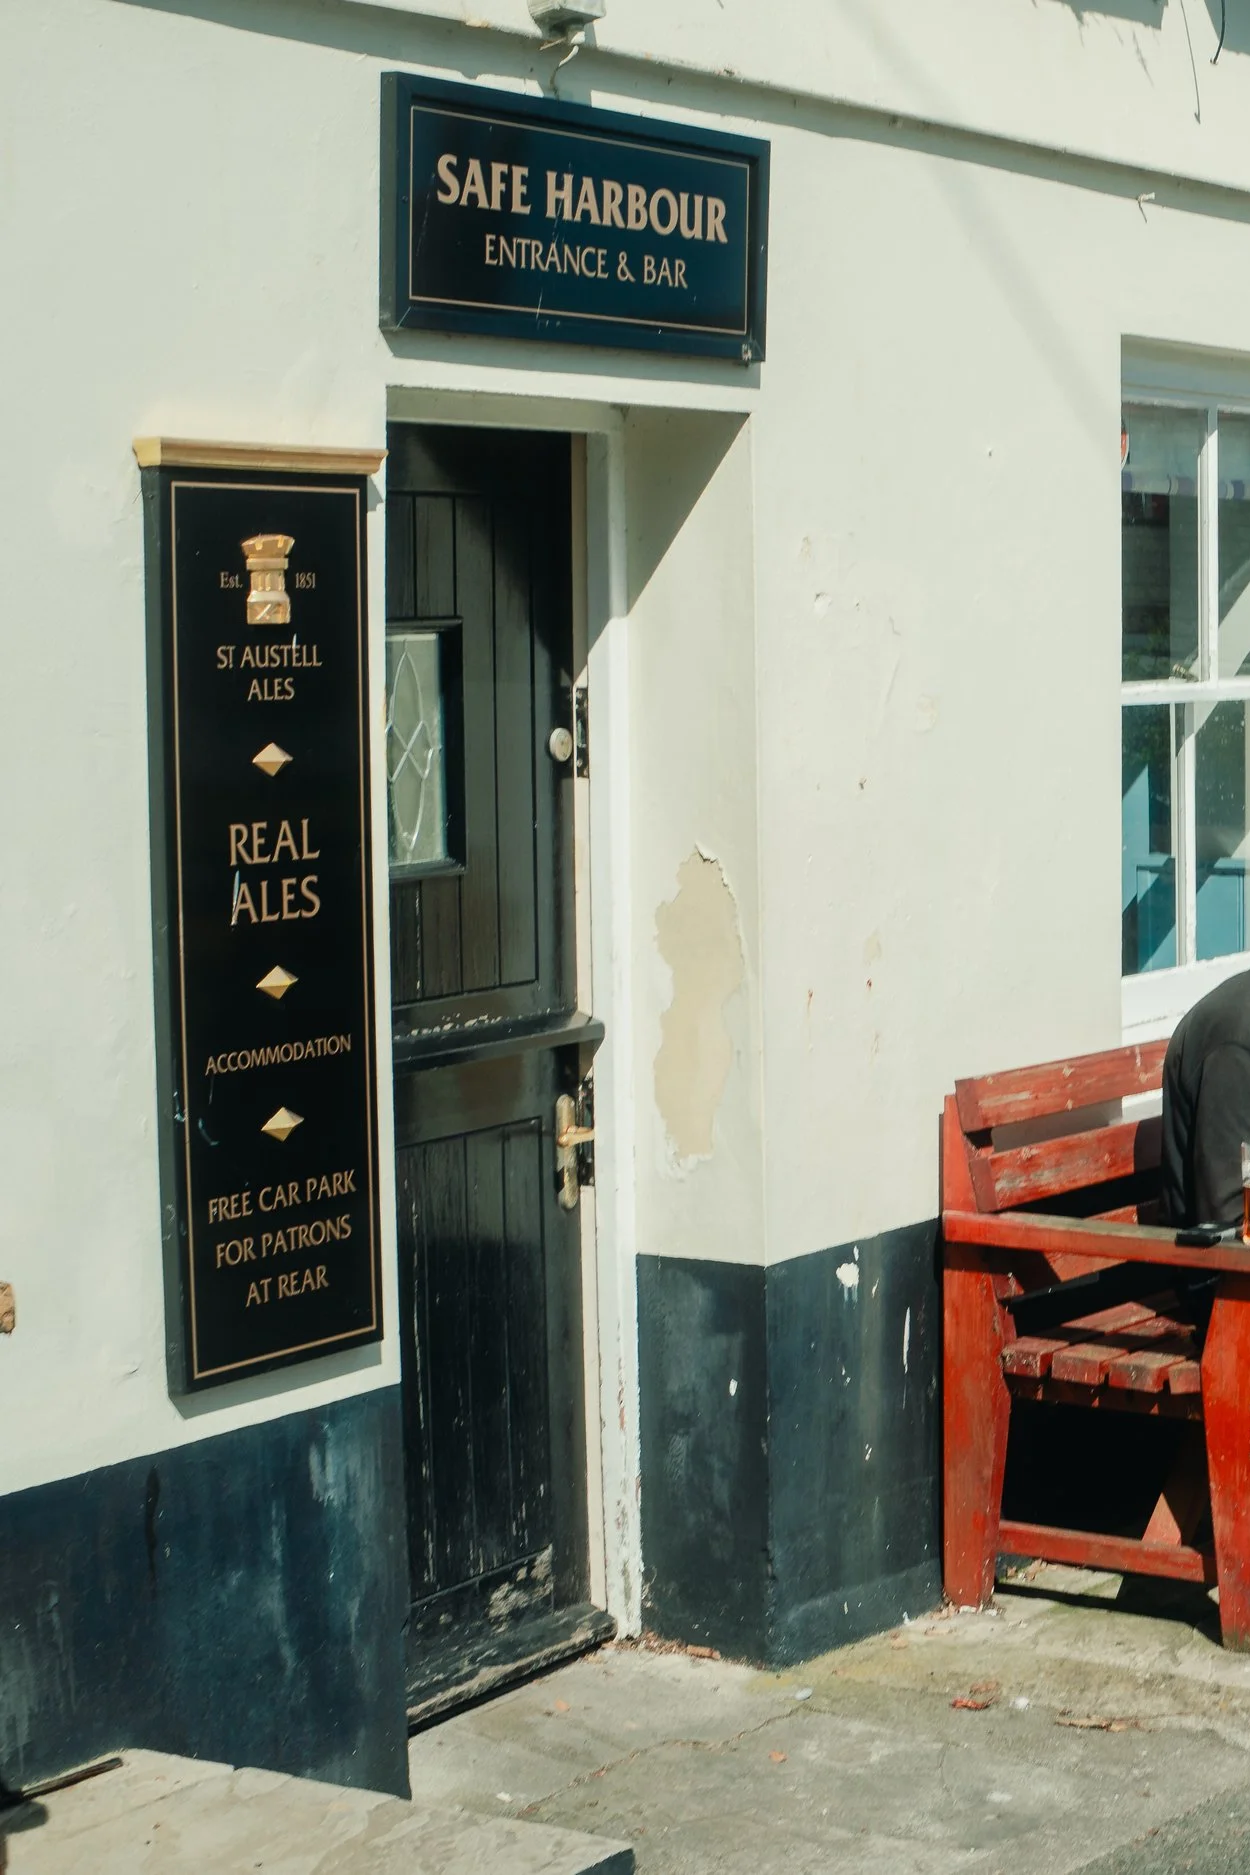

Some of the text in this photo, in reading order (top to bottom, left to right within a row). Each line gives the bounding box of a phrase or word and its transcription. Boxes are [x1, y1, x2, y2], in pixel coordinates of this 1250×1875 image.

[436, 153, 729, 244] SAFE HARBOUR
[485, 234, 688, 288] ENTRANCE & BAR
[220, 571, 316, 590] Est. 1851
[217, 645, 322, 669] ST AUSTELL
[247, 677, 296, 701] ALES
[229, 818, 321, 866] REAL
[230, 874, 321, 926] ALES
[205, 1033, 352, 1076] ACCOMMODATION
[208, 1169, 357, 1224] FREE CAR PARK
[215, 1214, 352, 1268] FOR PATRONS
[245, 1265, 329, 1308] AT REAR
